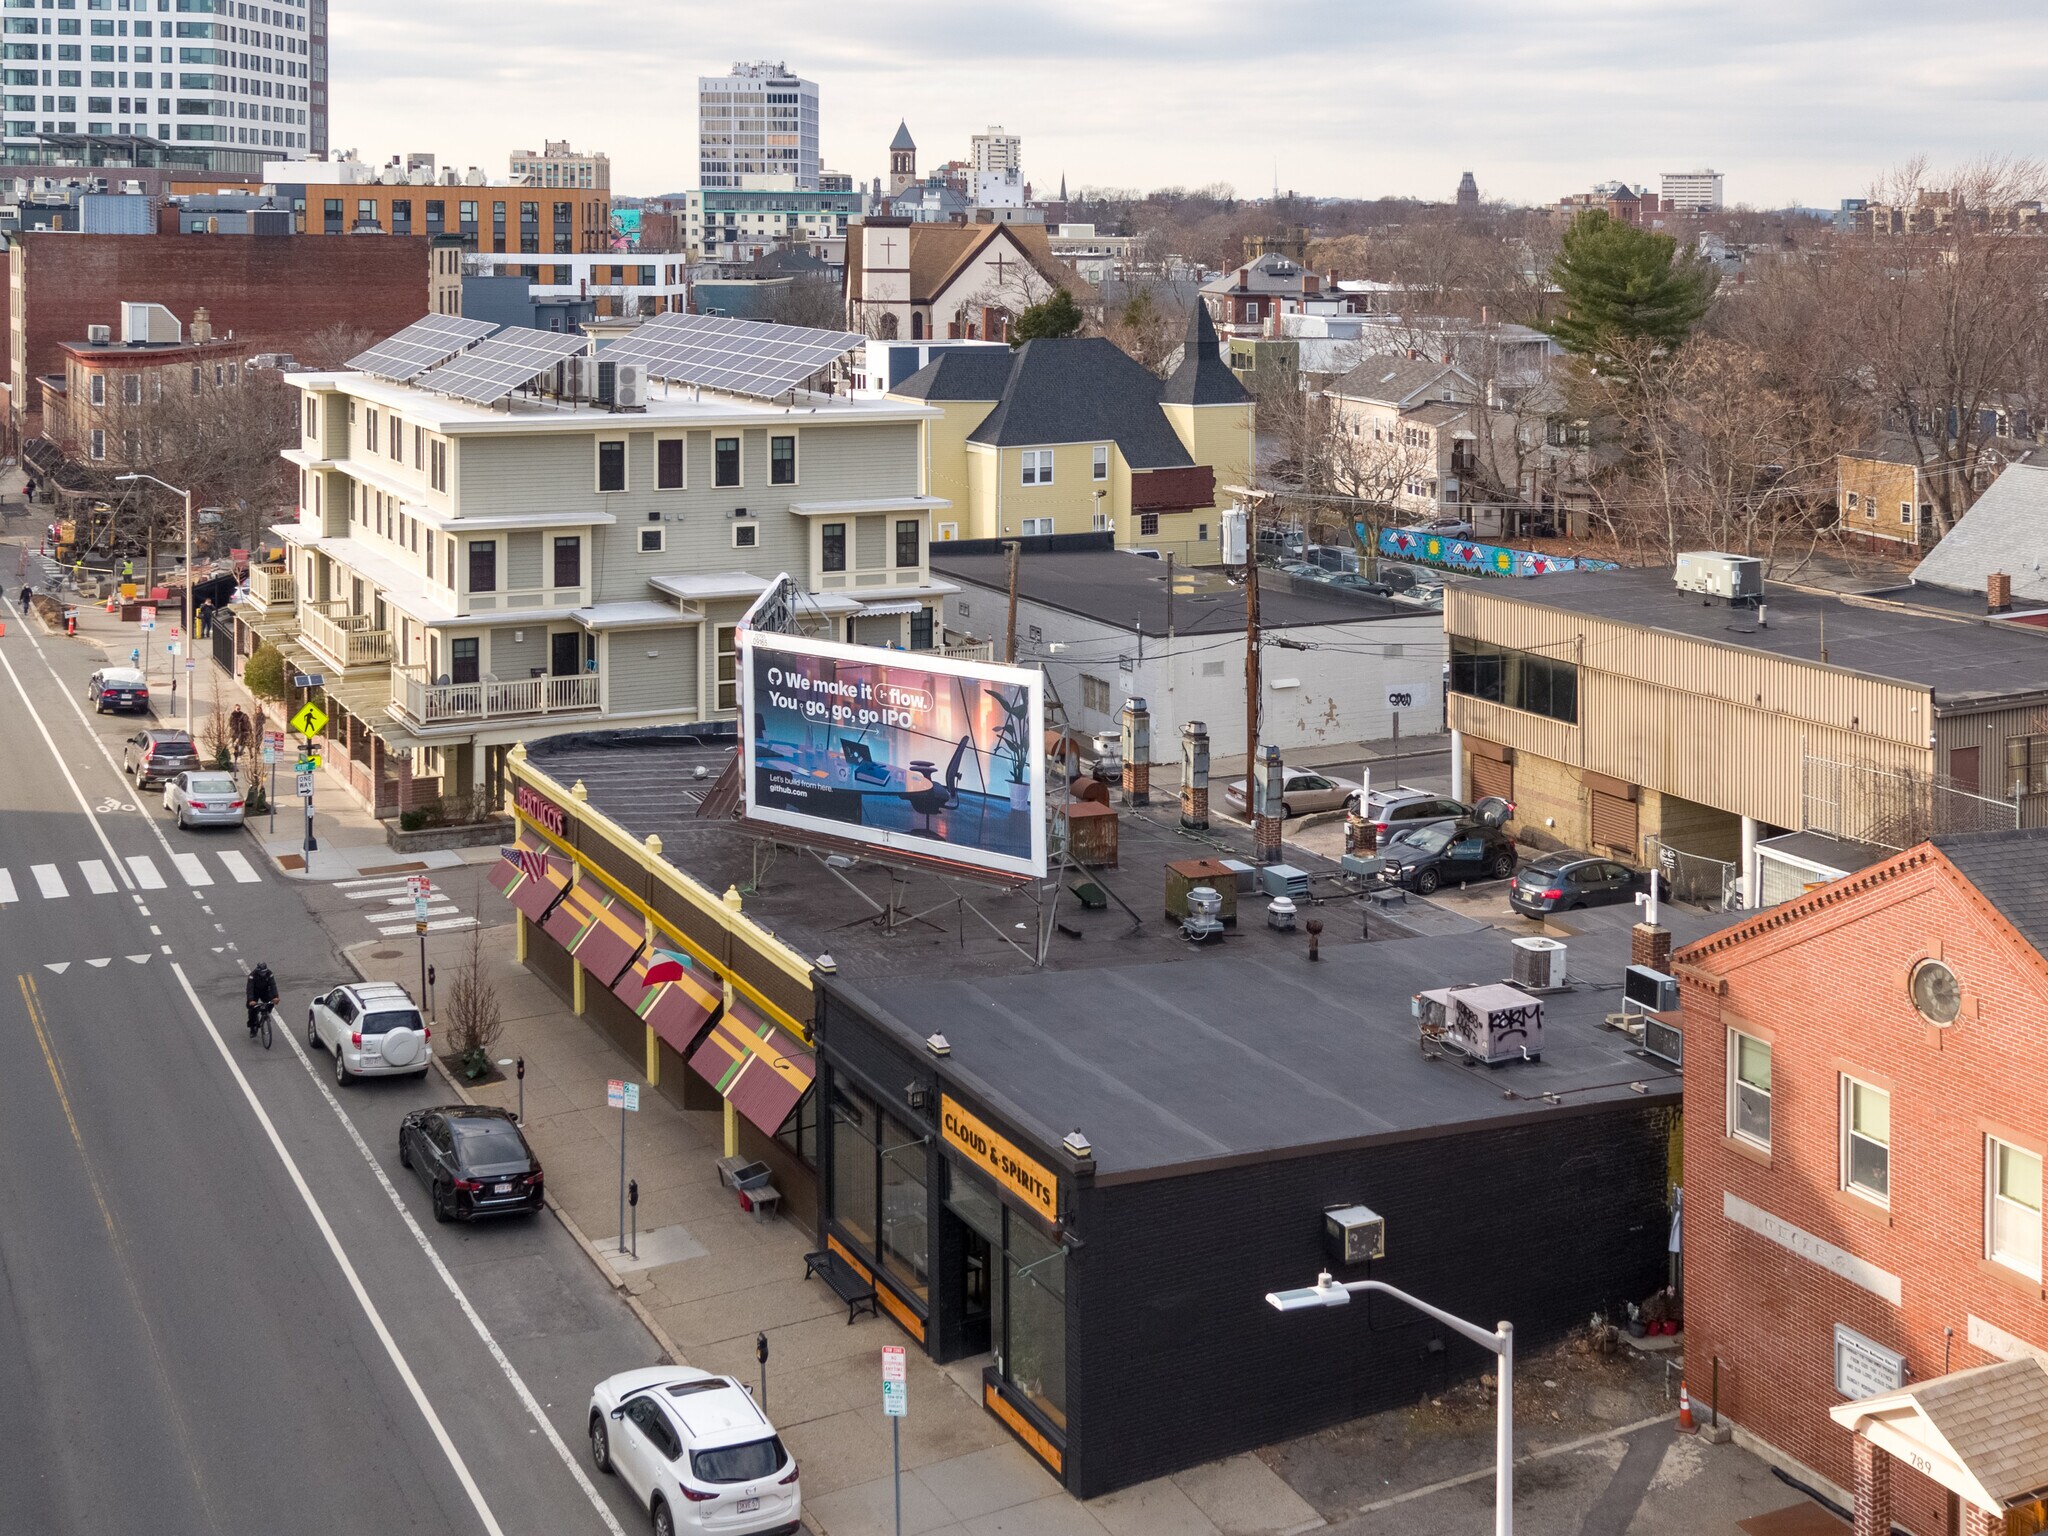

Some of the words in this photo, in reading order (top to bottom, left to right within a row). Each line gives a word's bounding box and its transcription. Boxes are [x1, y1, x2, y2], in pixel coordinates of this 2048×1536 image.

[785, 671, 810, 690] We
[813, 680, 858, 698] make
[861, 683, 872, 700] it
[889, 688, 928, 709] flow.
[768, 691, 797, 710] You
[806, 701, 829, 718] go,
[832, 705, 856, 722] go,
[859, 710, 878, 725] go
[882, 709, 917, 729] IPO.
[769, 774, 784, 783] Let's
[785, 777, 800, 786] build
[801, 780, 816, 789] from
[818, 783, 834, 792] here.
[769, 784, 808, 797] github.com
[518, 787, 563, 837] BERTUCCI'S
[945, 1113, 987, 1156] CLOUD
[990, 1146, 999, 1166] &
[1001, 1155, 1051, 1207] SPIRITS
[885, 1382, 891, 1391] 2
[1910, 1451, 1932, 1474] 789
